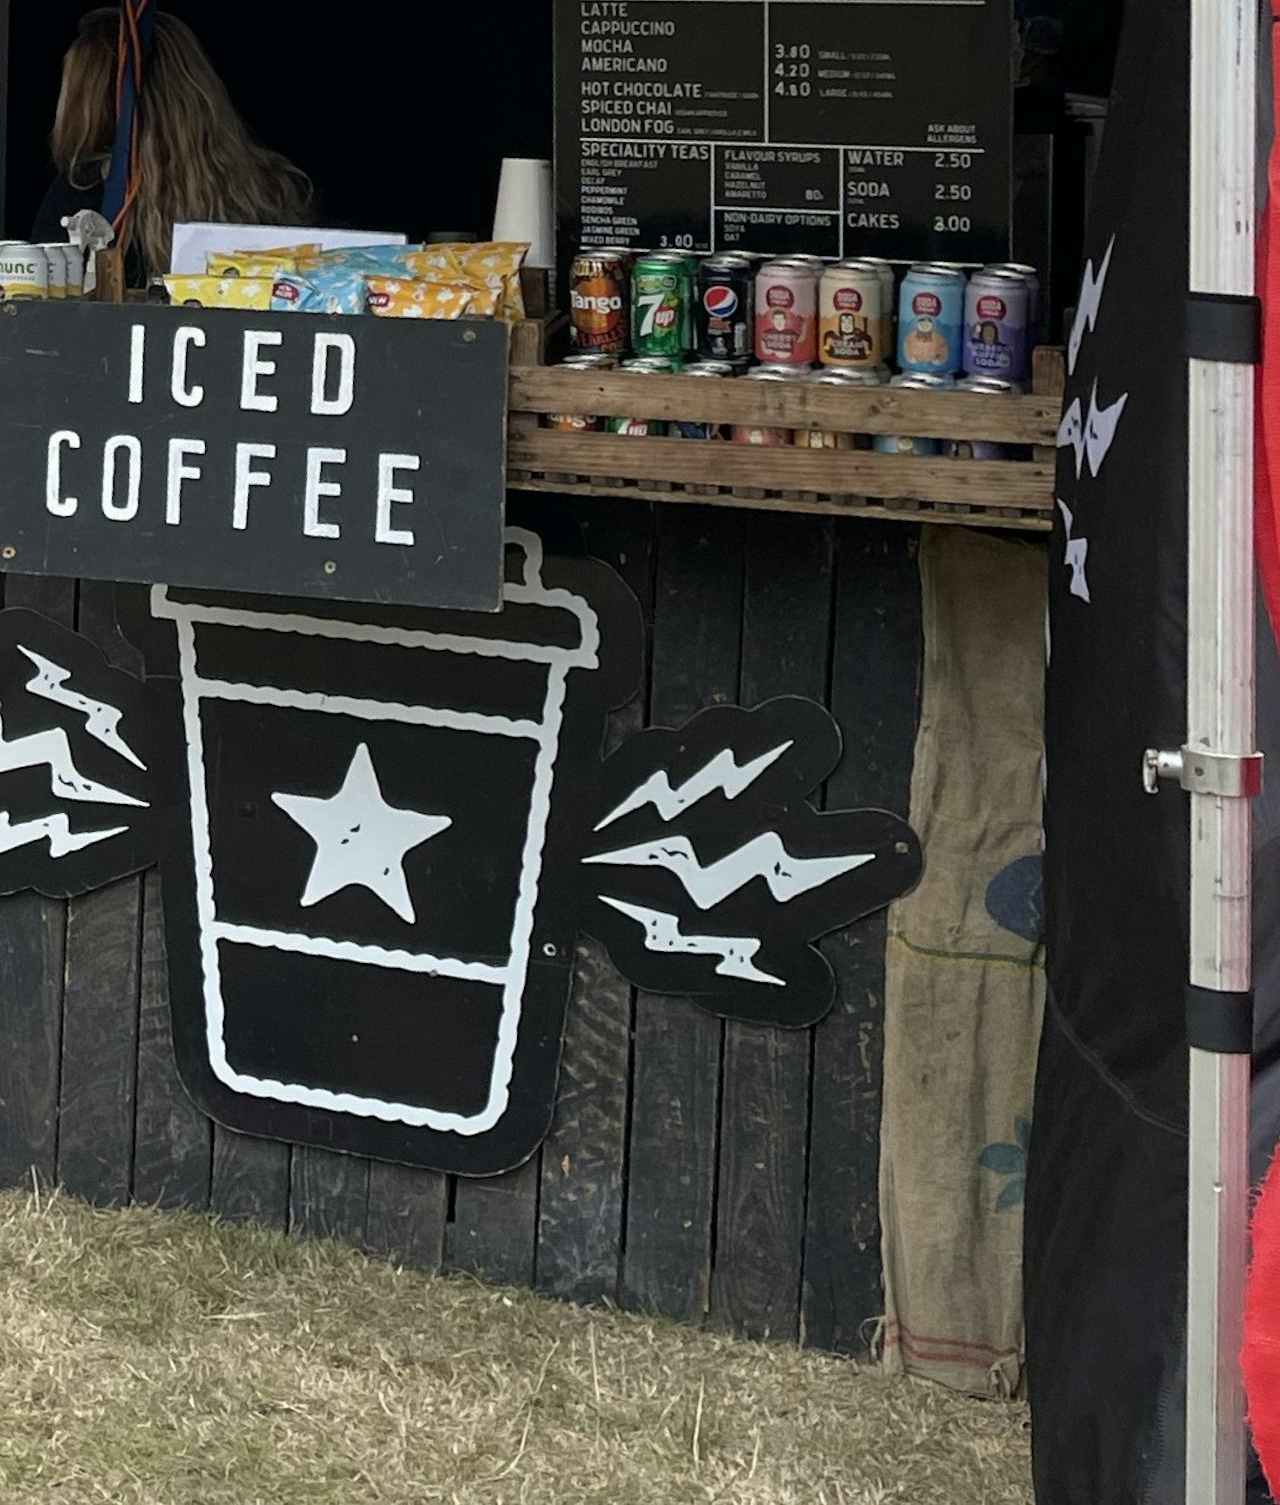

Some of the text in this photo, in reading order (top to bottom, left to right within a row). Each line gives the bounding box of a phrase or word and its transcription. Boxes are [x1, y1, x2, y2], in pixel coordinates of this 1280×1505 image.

[580, 3, 628, 17] LATTE
[580, 21, 675, 36] CAPPUCCINO
[581, 39, 633, 53] MOCHA
[581, 57, 668, 72] AMERICANO
[775, 62, 810, 77] 4.20
[581, 82, 609, 96] HOT
[614, 82, 702, 98] CHOCOLATE
[581, 100, 633, 114] SPICED
[636, 101, 672, 115] CHAI
[581, 118, 640, 133] LONDON
[644, 119, 675, 134] FOG
[947, 124, 976, 133] ABOUT
[927, 134, 977, 144] ALLERGENS
[581, 142, 709, 160] SPECIALITY TEAS
[724, 149, 821, 163] FLAVOUR SYRUPS
[847, 151, 972, 168] WATER 2.50
[847, 181, 972, 200] SODA 2.50
[723, 212, 831, 226] NON-DAIRY OPTIONS
[847, 213, 900, 229] CAKES
[660, 233, 693, 248] 3.00
[129, 324, 356, 415] ICED
[46, 429, 420, 545] COFFEE
